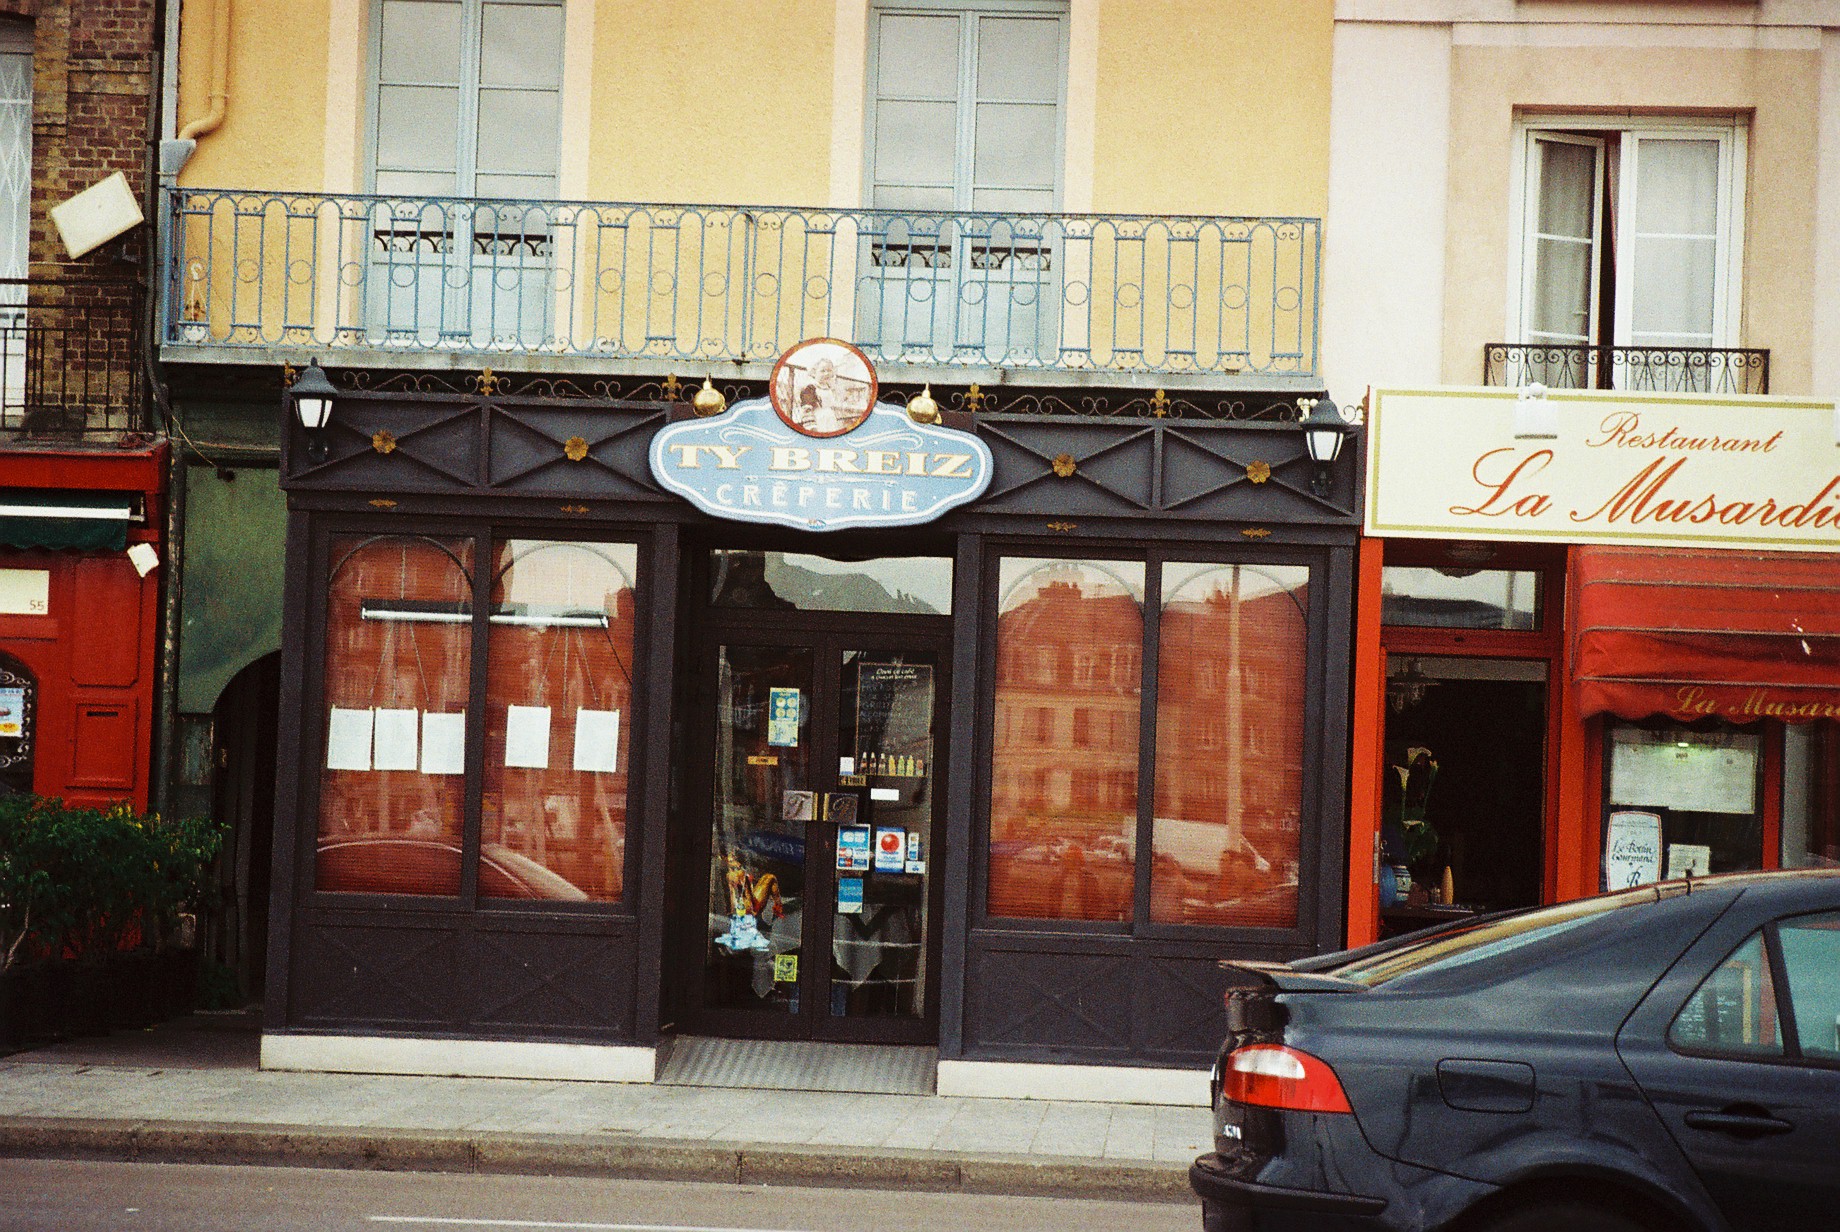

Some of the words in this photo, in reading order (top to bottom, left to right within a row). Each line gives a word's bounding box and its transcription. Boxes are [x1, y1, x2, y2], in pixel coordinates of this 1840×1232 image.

[1585, 410, 1784, 454] Restaurant
[668, 443, 752, 470] TY
[768, 445, 975, 479] BREIZ
[715, 481, 918, 513] CRÊPERIE
[1449, 447, 1555, 518] La
[1570, 456, 1840, 530] Musardi
[1671, 686, 1716, 714] La
